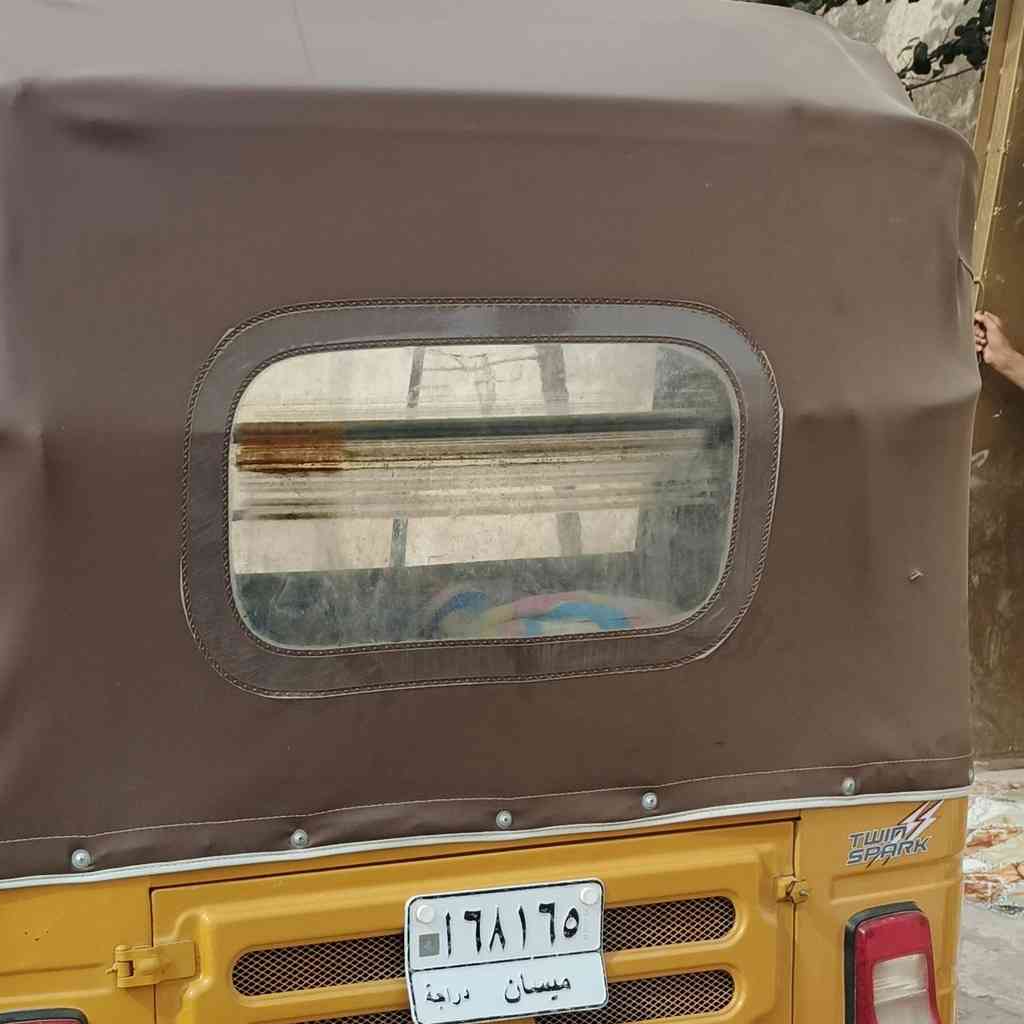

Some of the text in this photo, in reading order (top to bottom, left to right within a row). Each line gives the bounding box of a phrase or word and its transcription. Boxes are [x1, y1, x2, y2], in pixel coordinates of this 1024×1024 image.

[847, 839, 928, 865] SPARK
[445, 902, 580, 959] ١٦٨١٦٥
[504, 973, 572, 1004] ميسان
